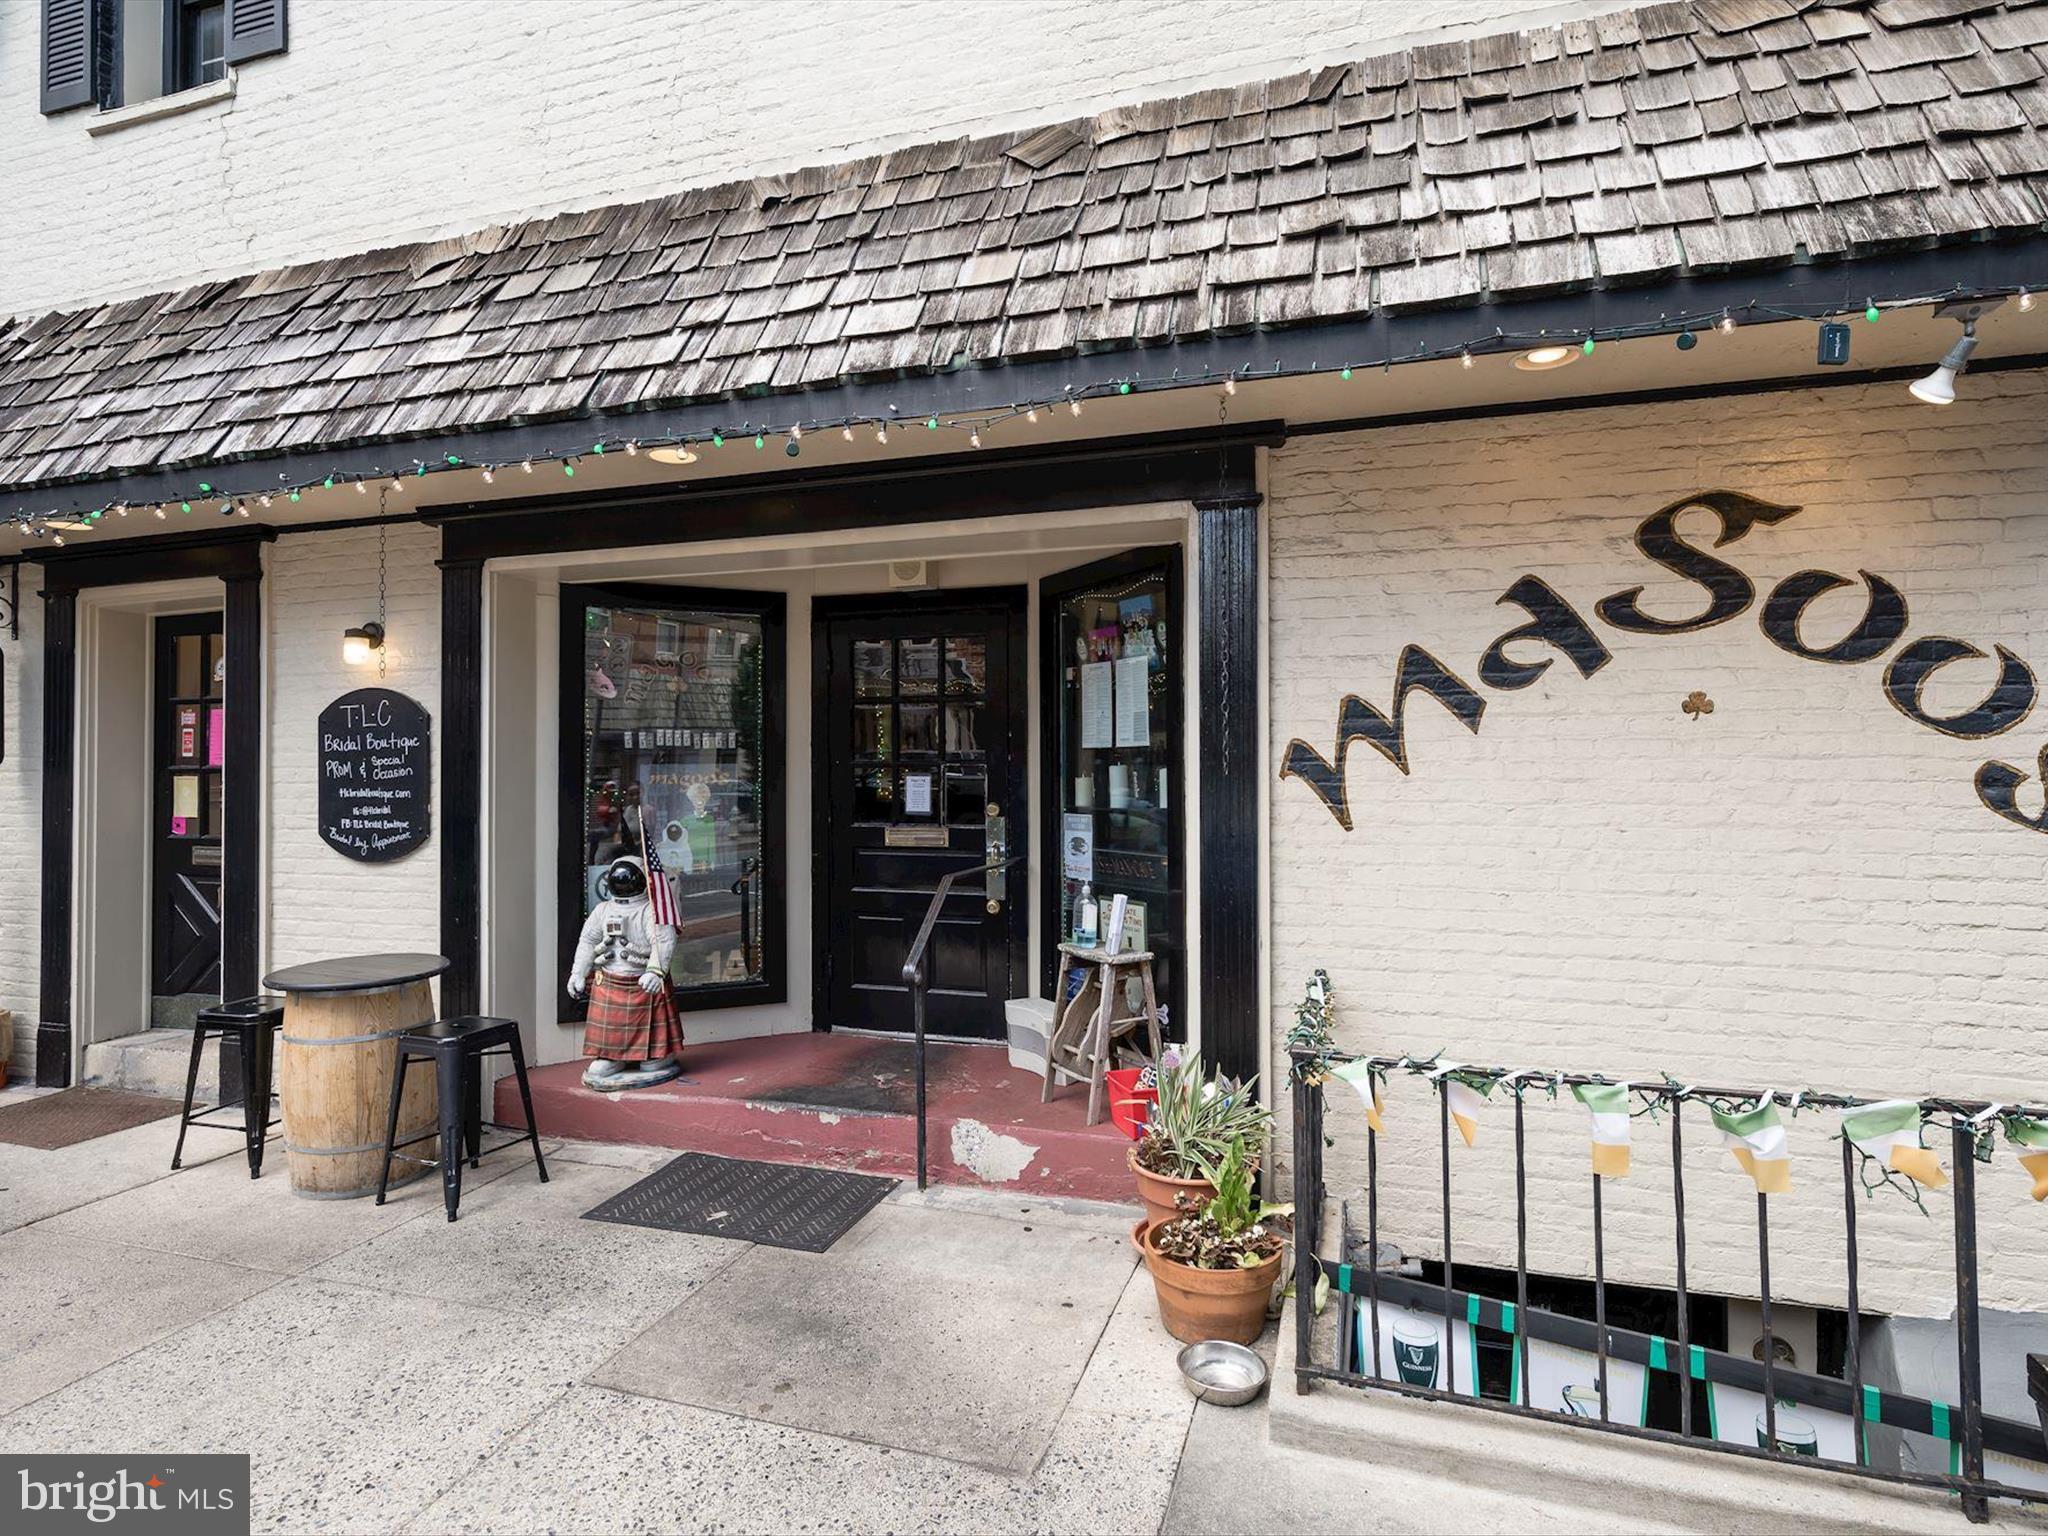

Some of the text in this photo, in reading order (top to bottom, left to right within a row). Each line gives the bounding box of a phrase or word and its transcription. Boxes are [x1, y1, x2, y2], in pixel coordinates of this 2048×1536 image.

[366, 732, 420, 755] Boutique
[326, 760, 352, 779] PROM
[1402, 1361, 1432, 1371] GUINNESS
